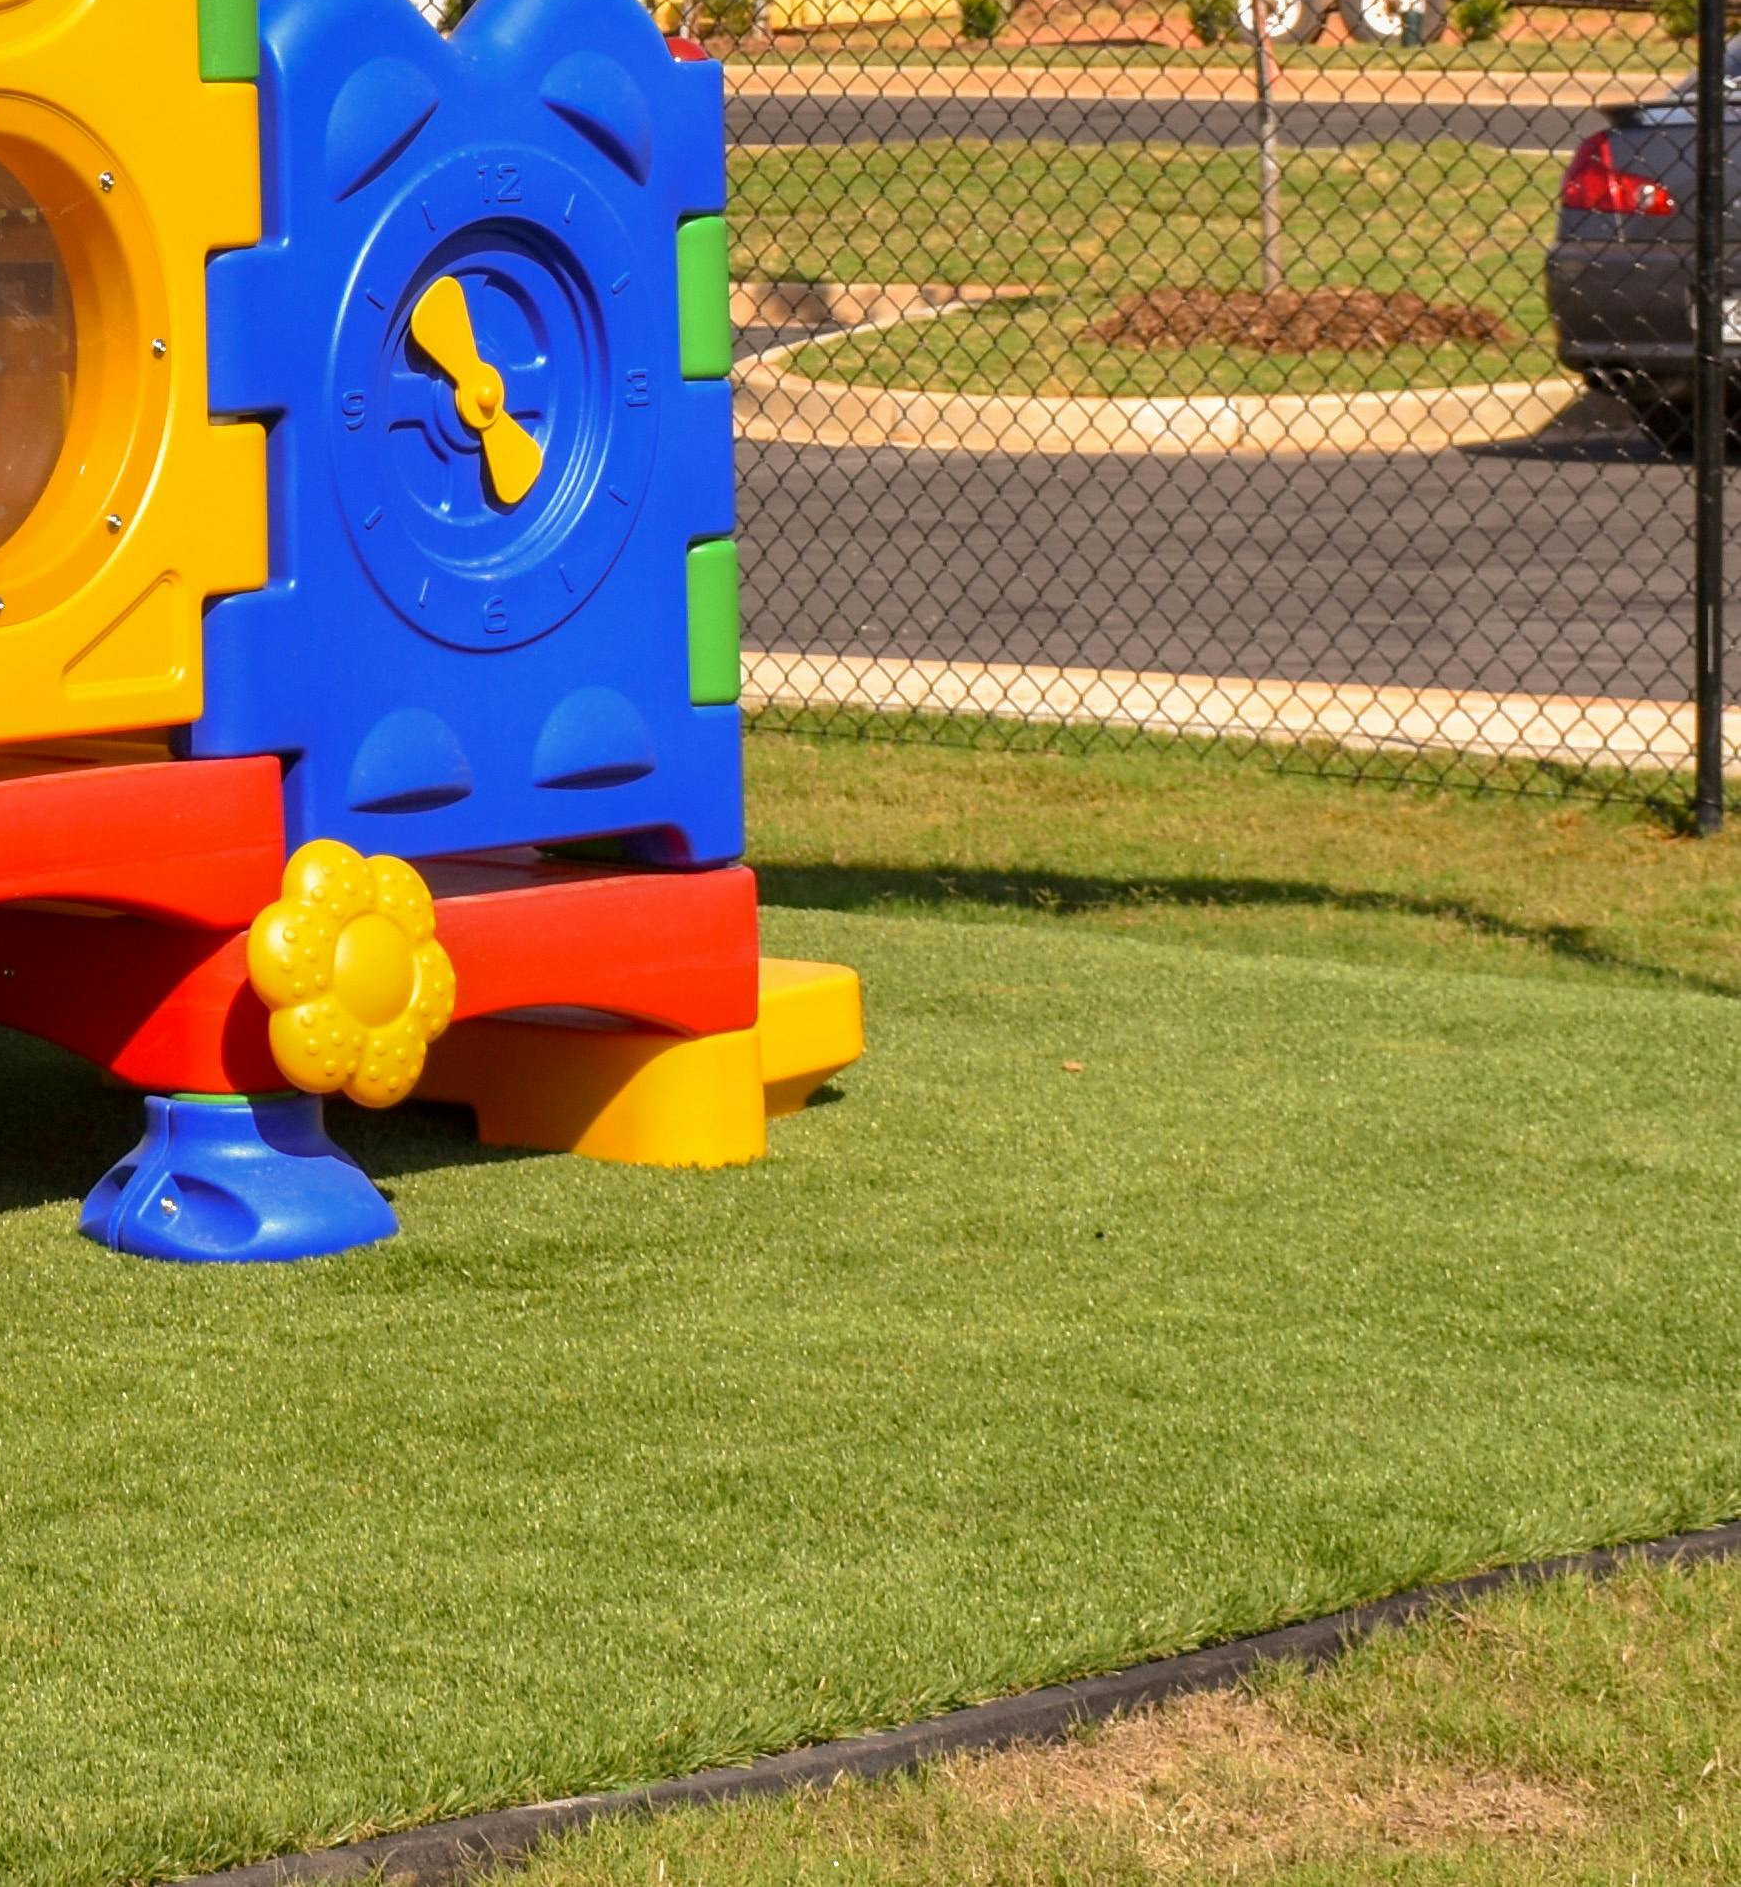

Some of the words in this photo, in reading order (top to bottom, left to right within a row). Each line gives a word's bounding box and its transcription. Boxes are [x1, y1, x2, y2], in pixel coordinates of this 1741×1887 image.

[477, 162, 523, 203] 12
[625, 367, 650, 408] 3
[341, 389, 366, 430] 9
[482, 595, 509, 635] 6
